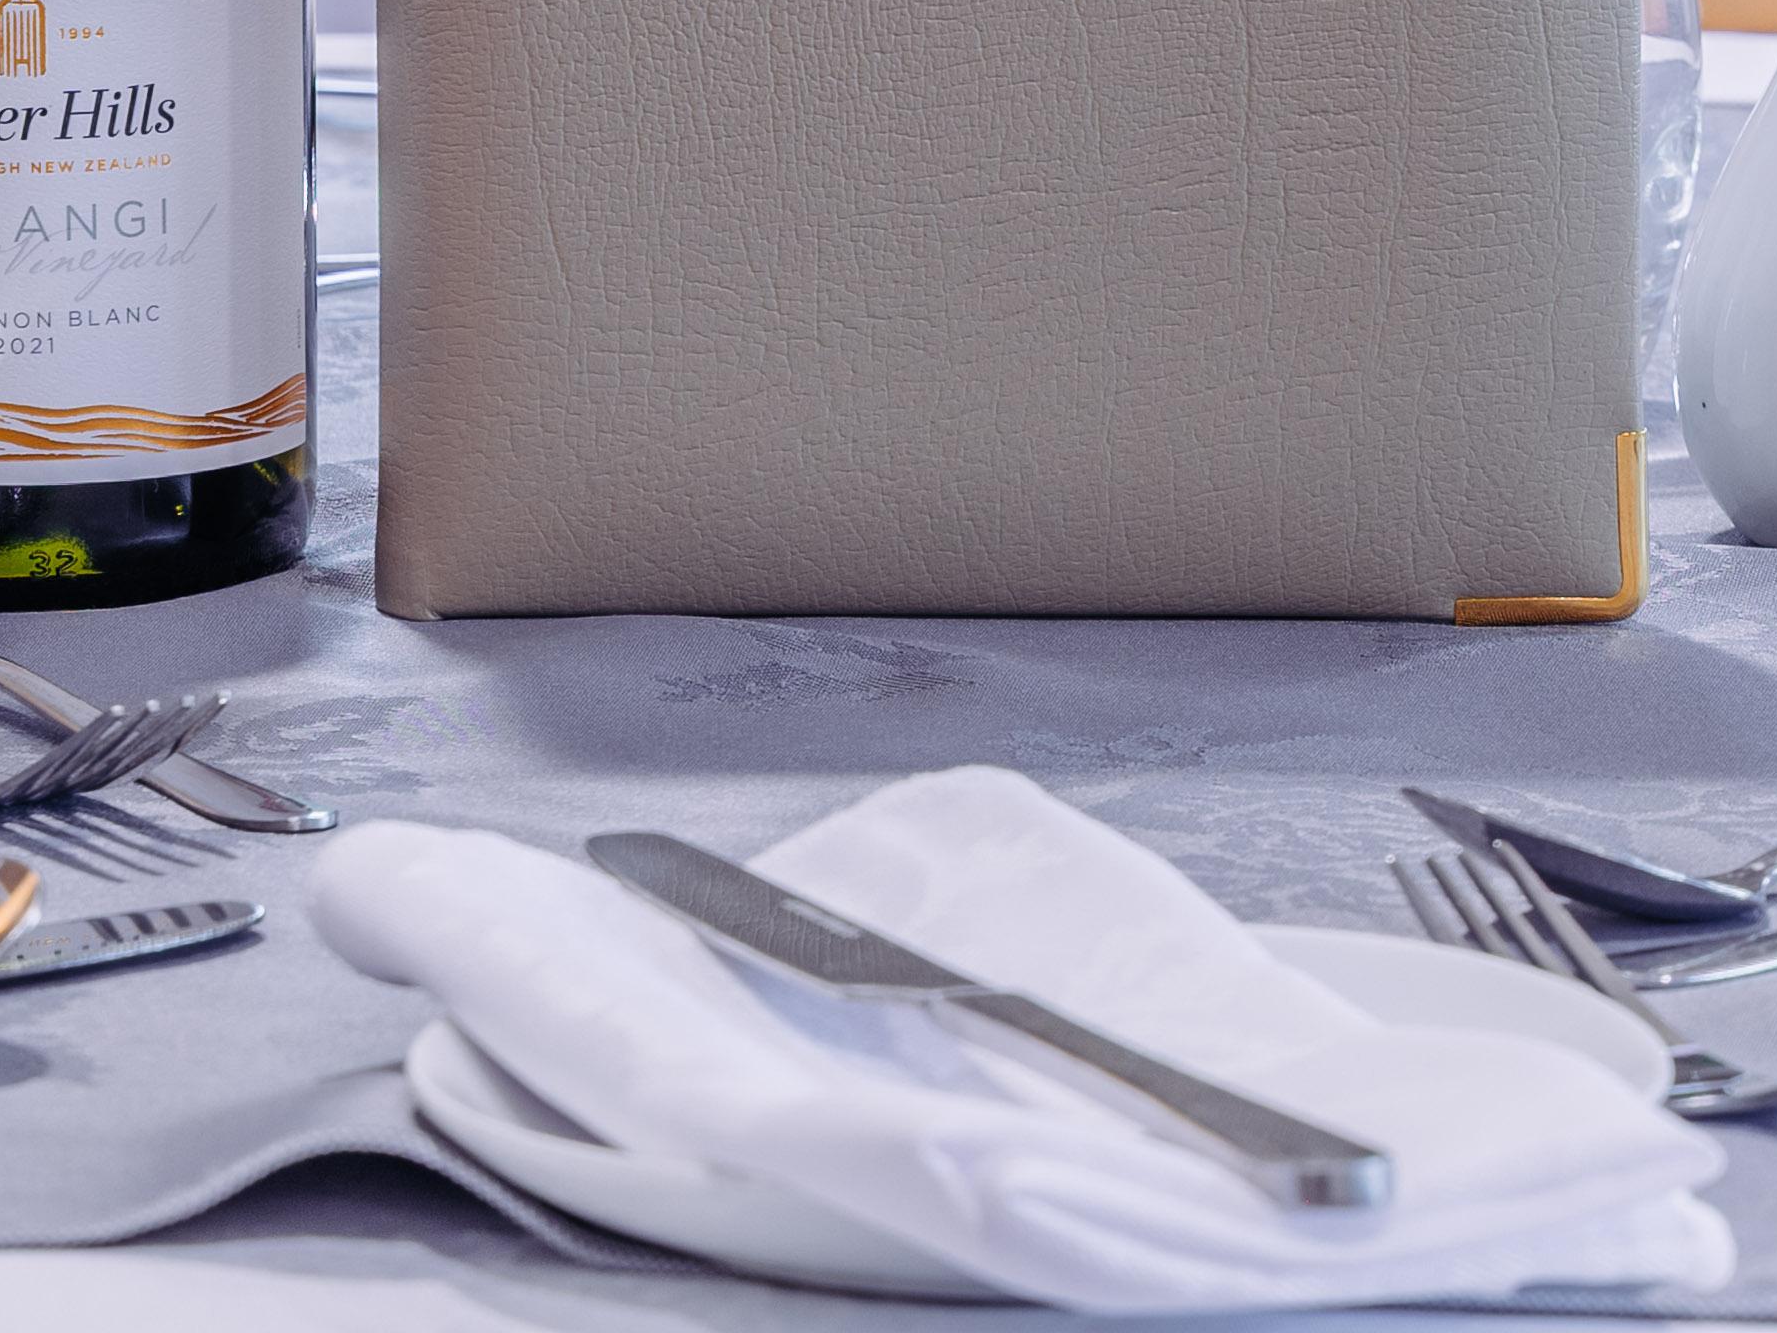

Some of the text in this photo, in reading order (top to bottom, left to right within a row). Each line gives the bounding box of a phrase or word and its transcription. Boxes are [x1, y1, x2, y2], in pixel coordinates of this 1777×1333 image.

[59, 26, 105, 40] 1994
[54, 84, 176, 140] Hills
[31, 160, 74, 175] NEW
[85, 154, 172, 173] ZEALAND
[69, 304, 160, 327] BLANC
[29, 549, 78, 578] 32
